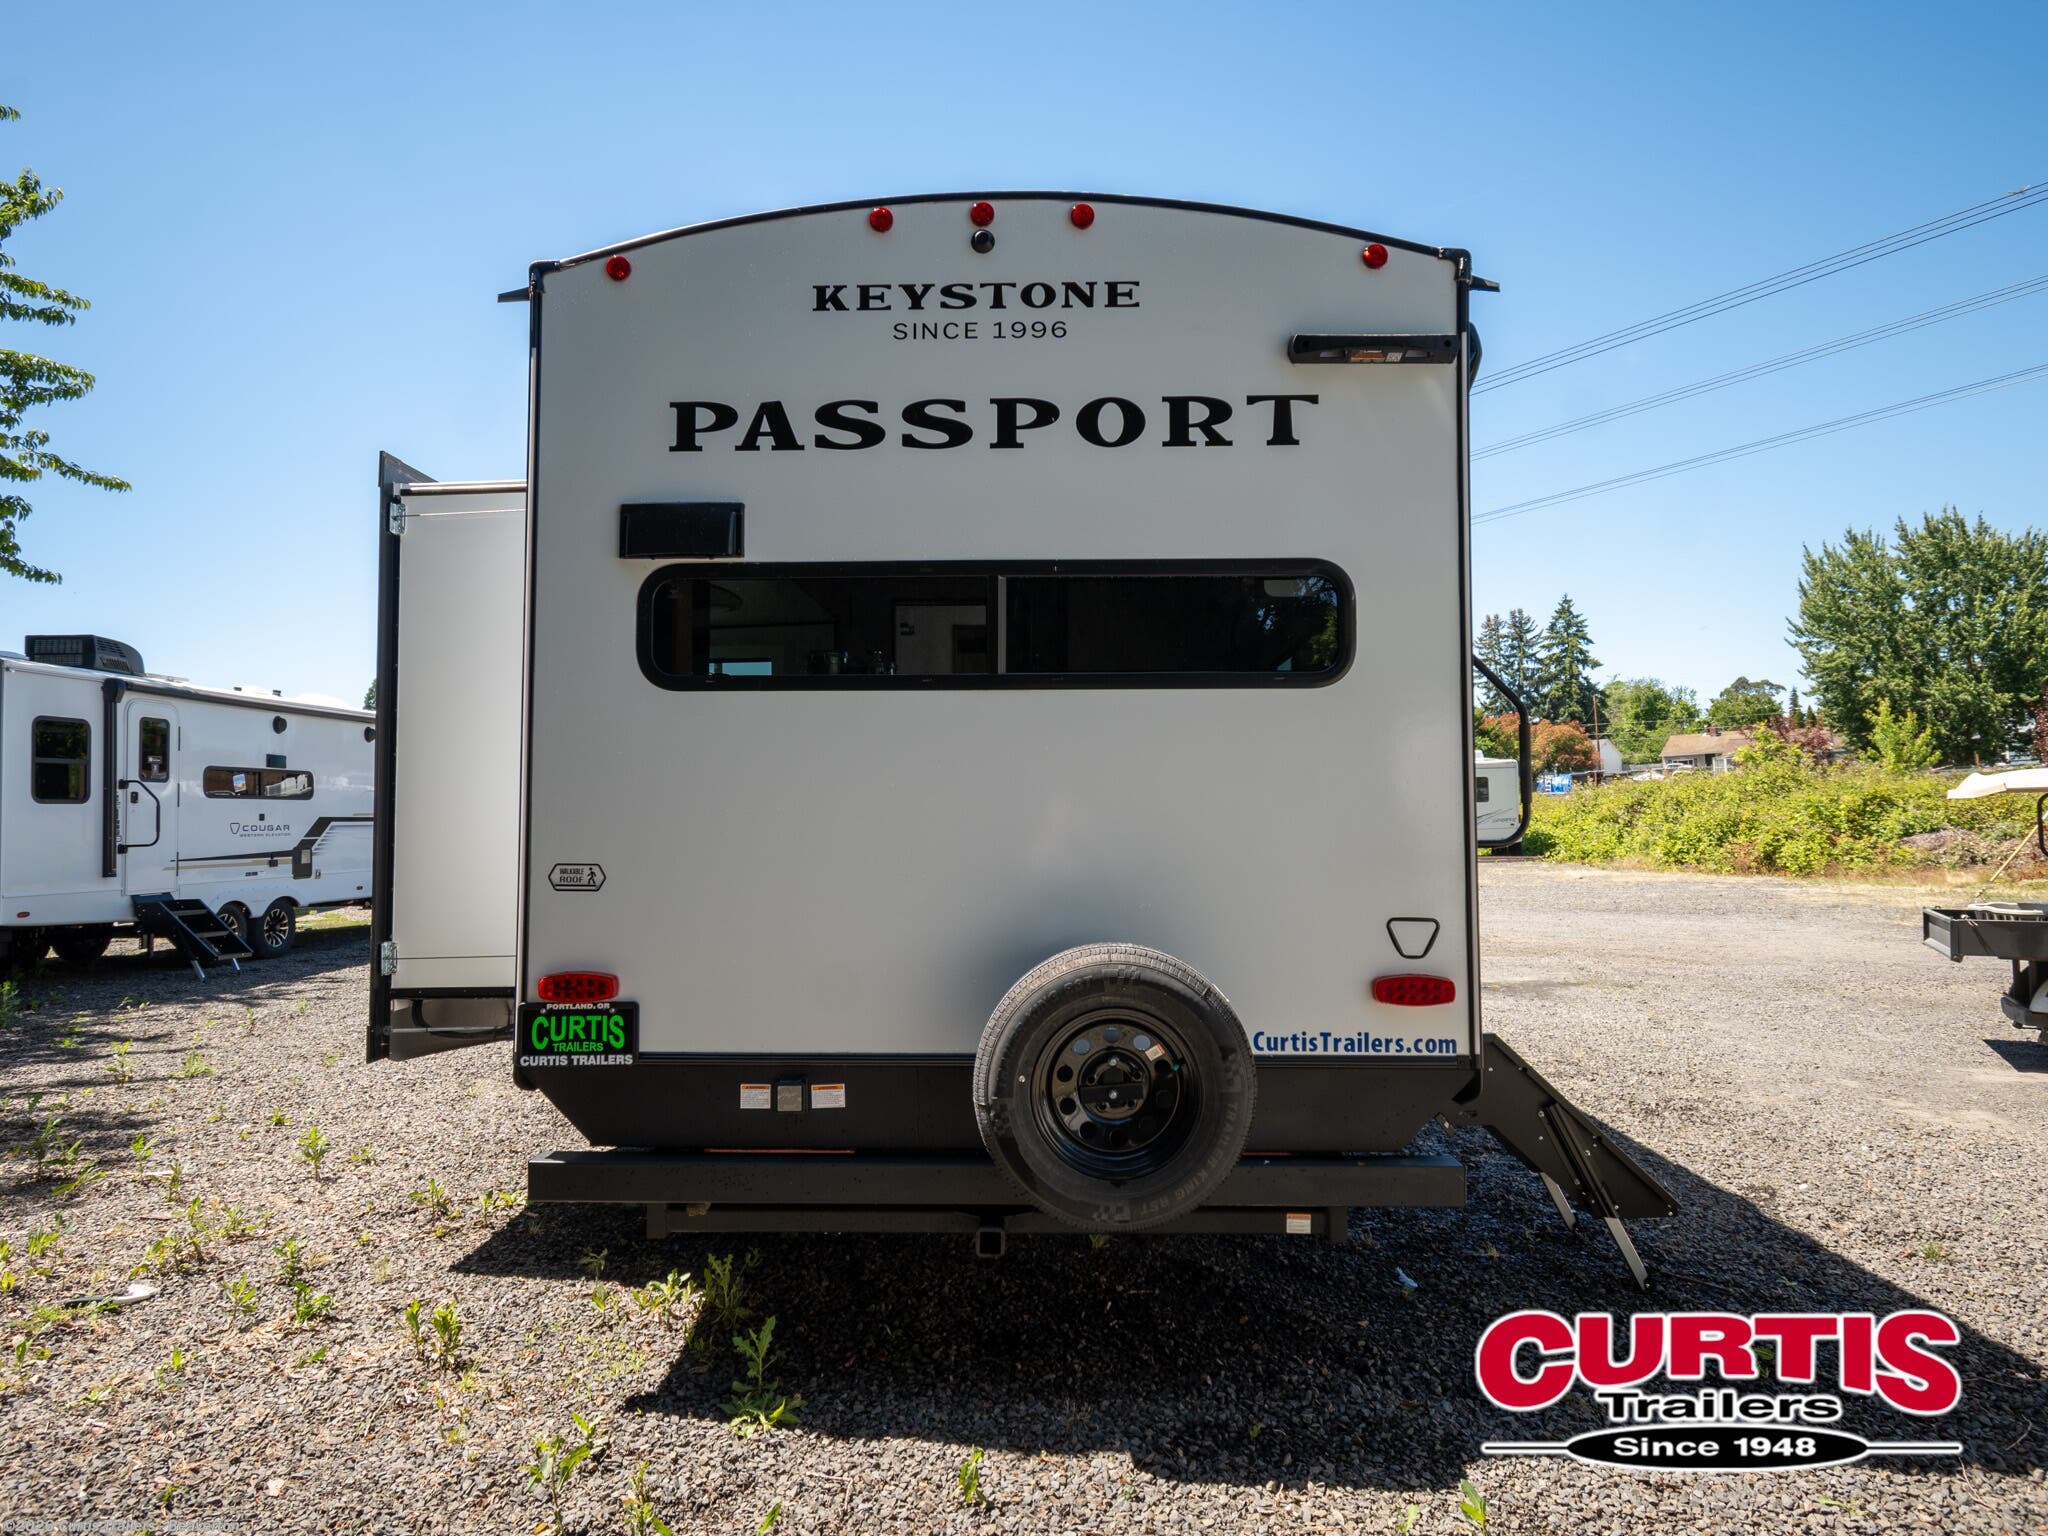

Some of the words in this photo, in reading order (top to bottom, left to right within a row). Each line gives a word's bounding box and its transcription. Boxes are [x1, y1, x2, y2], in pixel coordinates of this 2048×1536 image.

[811, 281, 1141, 312] KEYSTONE
[892, 322, 979, 340] SINCE
[992, 321, 1067, 339] 1996
[668, 394, 1319, 452] PASSPORT
[242, 824, 290, 832] COUGAR
[531, 1014, 625, 1050] CURTIS
[1253, 1031, 1457, 1054] CurtisTrailers.com
[552, 1041, 604, 1052] TRAILERS
[520, 1055, 568, 1067] CURTIS
[571, 1054, 633, 1066] TRAILERS
